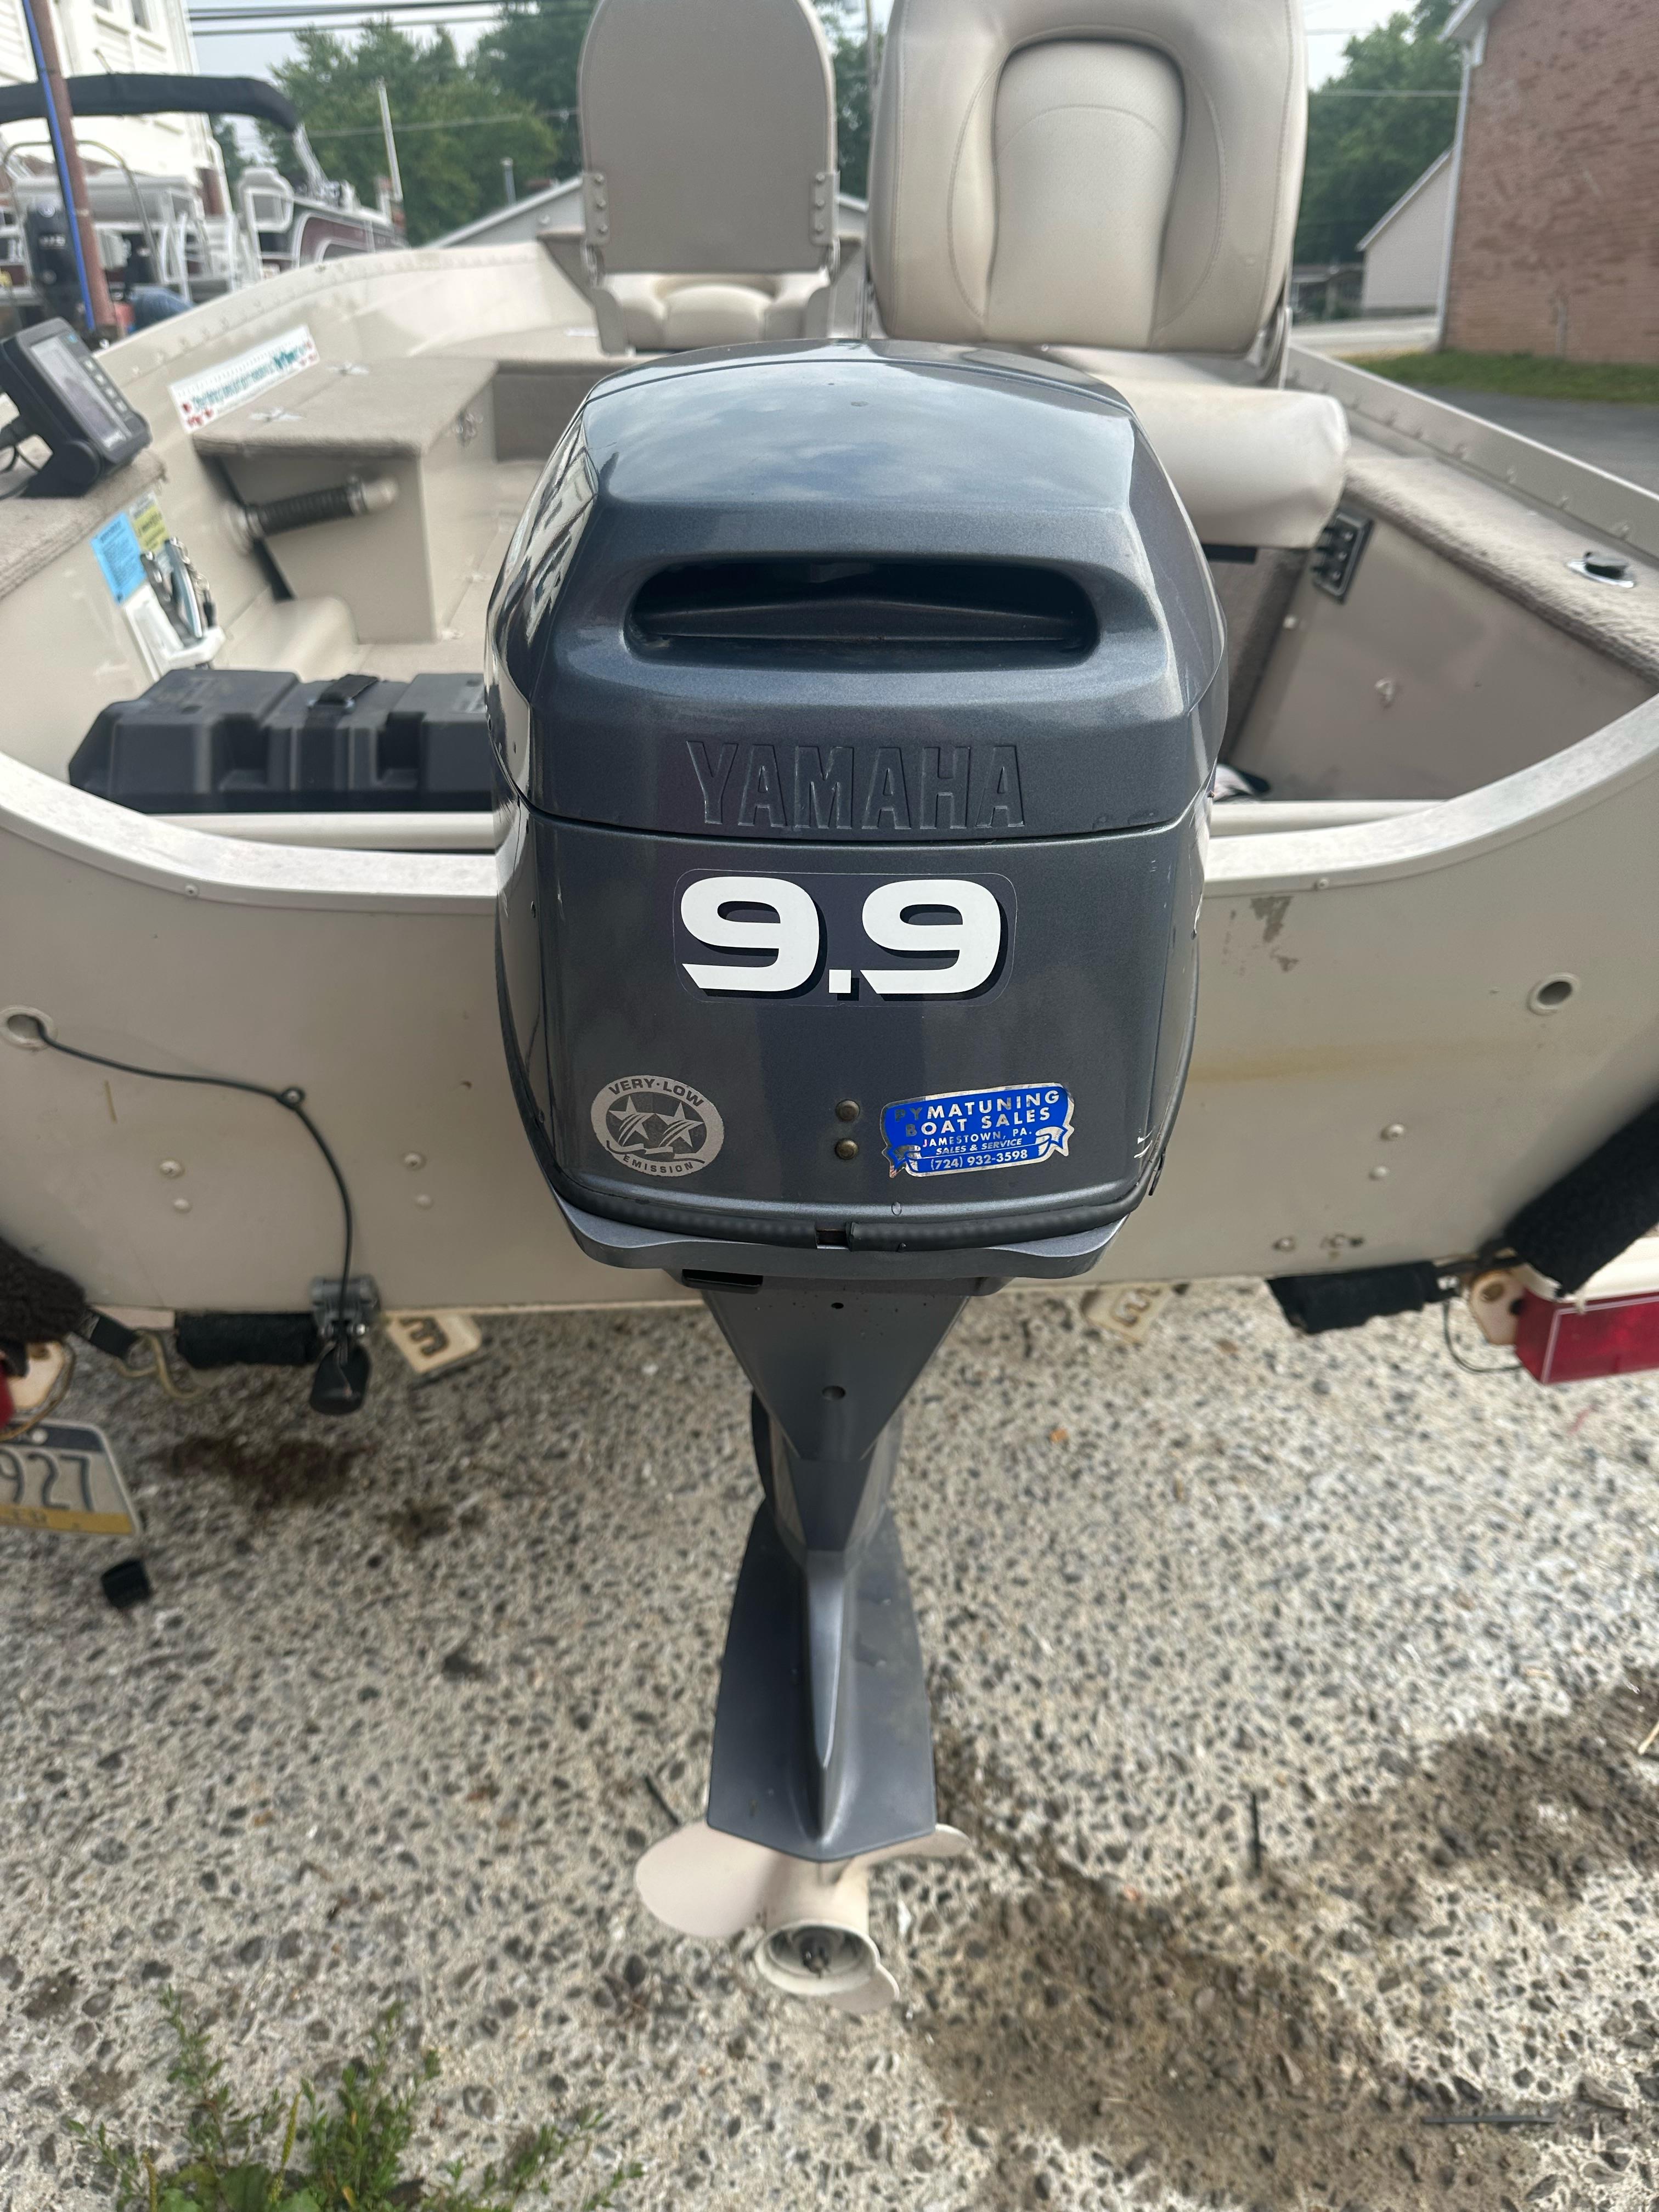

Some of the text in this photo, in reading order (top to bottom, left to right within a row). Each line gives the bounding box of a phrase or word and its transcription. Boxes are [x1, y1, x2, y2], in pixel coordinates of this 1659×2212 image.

[686, 740, 1025, 830] YAMAHA
[680, 876, 1005, 996] 9.9
[895, 1090, 1060, 1122] PYMATUNING
[905, 1107, 1051, 1137] BOAT SALES
[922, 1127, 1032, 1148] JAMESTOWN, PA.
[935, 1145, 967, 1155] SALES
[981, 1138, 1023, 1150] SERVICE
[622, 1154, 694, 1173] EMISSION
[930, 1149, 1028, 1171] (724) 932-3598
